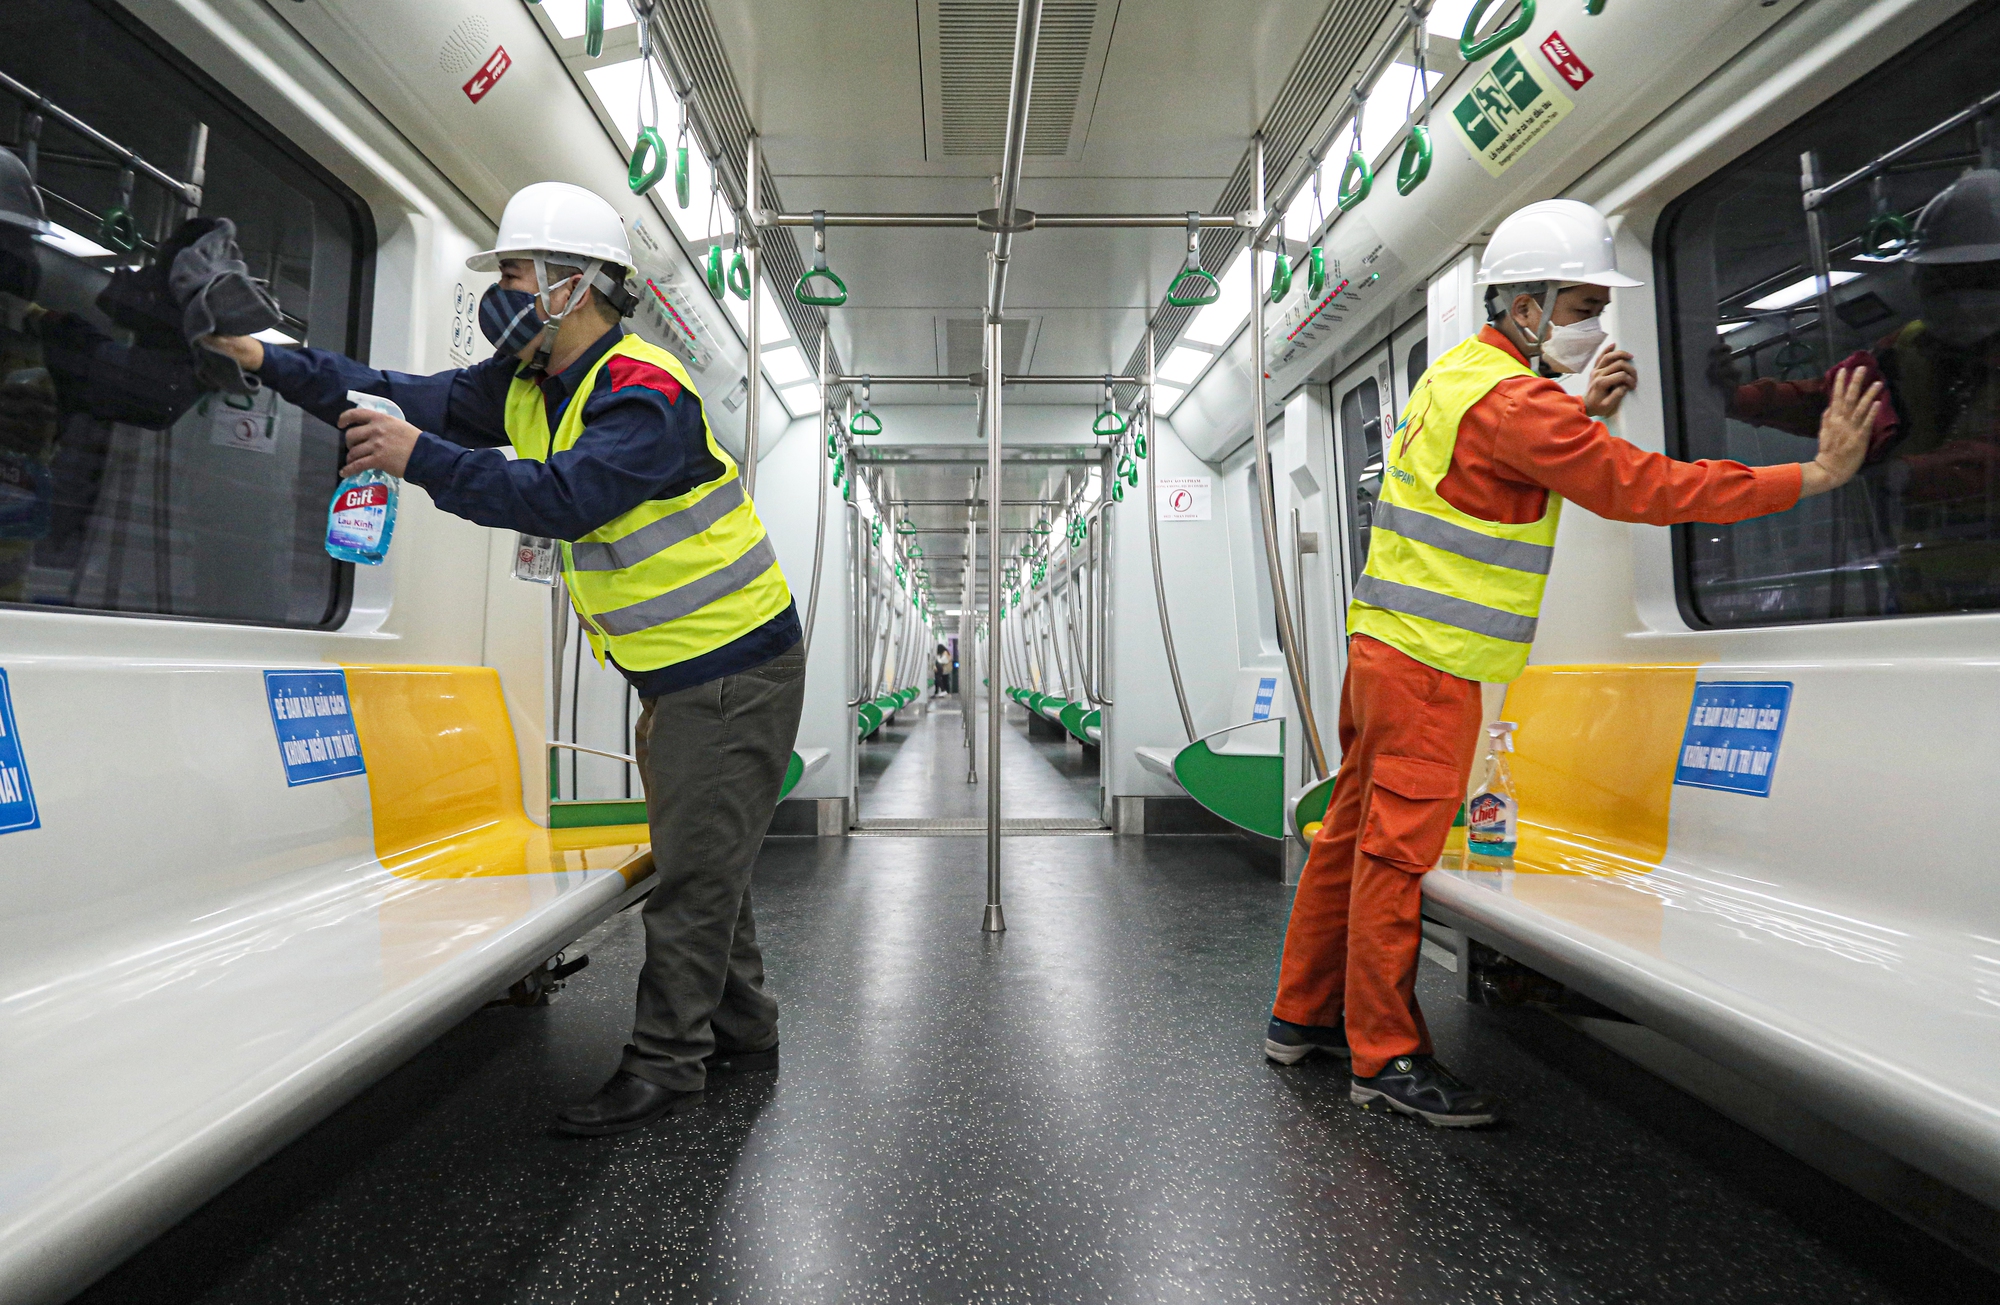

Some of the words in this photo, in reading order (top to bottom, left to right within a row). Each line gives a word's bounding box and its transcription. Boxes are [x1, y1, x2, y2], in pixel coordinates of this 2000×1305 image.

[346, 489, 374, 507] Gift
[337, 517, 351, 525] Lau
[1471, 802, 1500, 823] Chief
